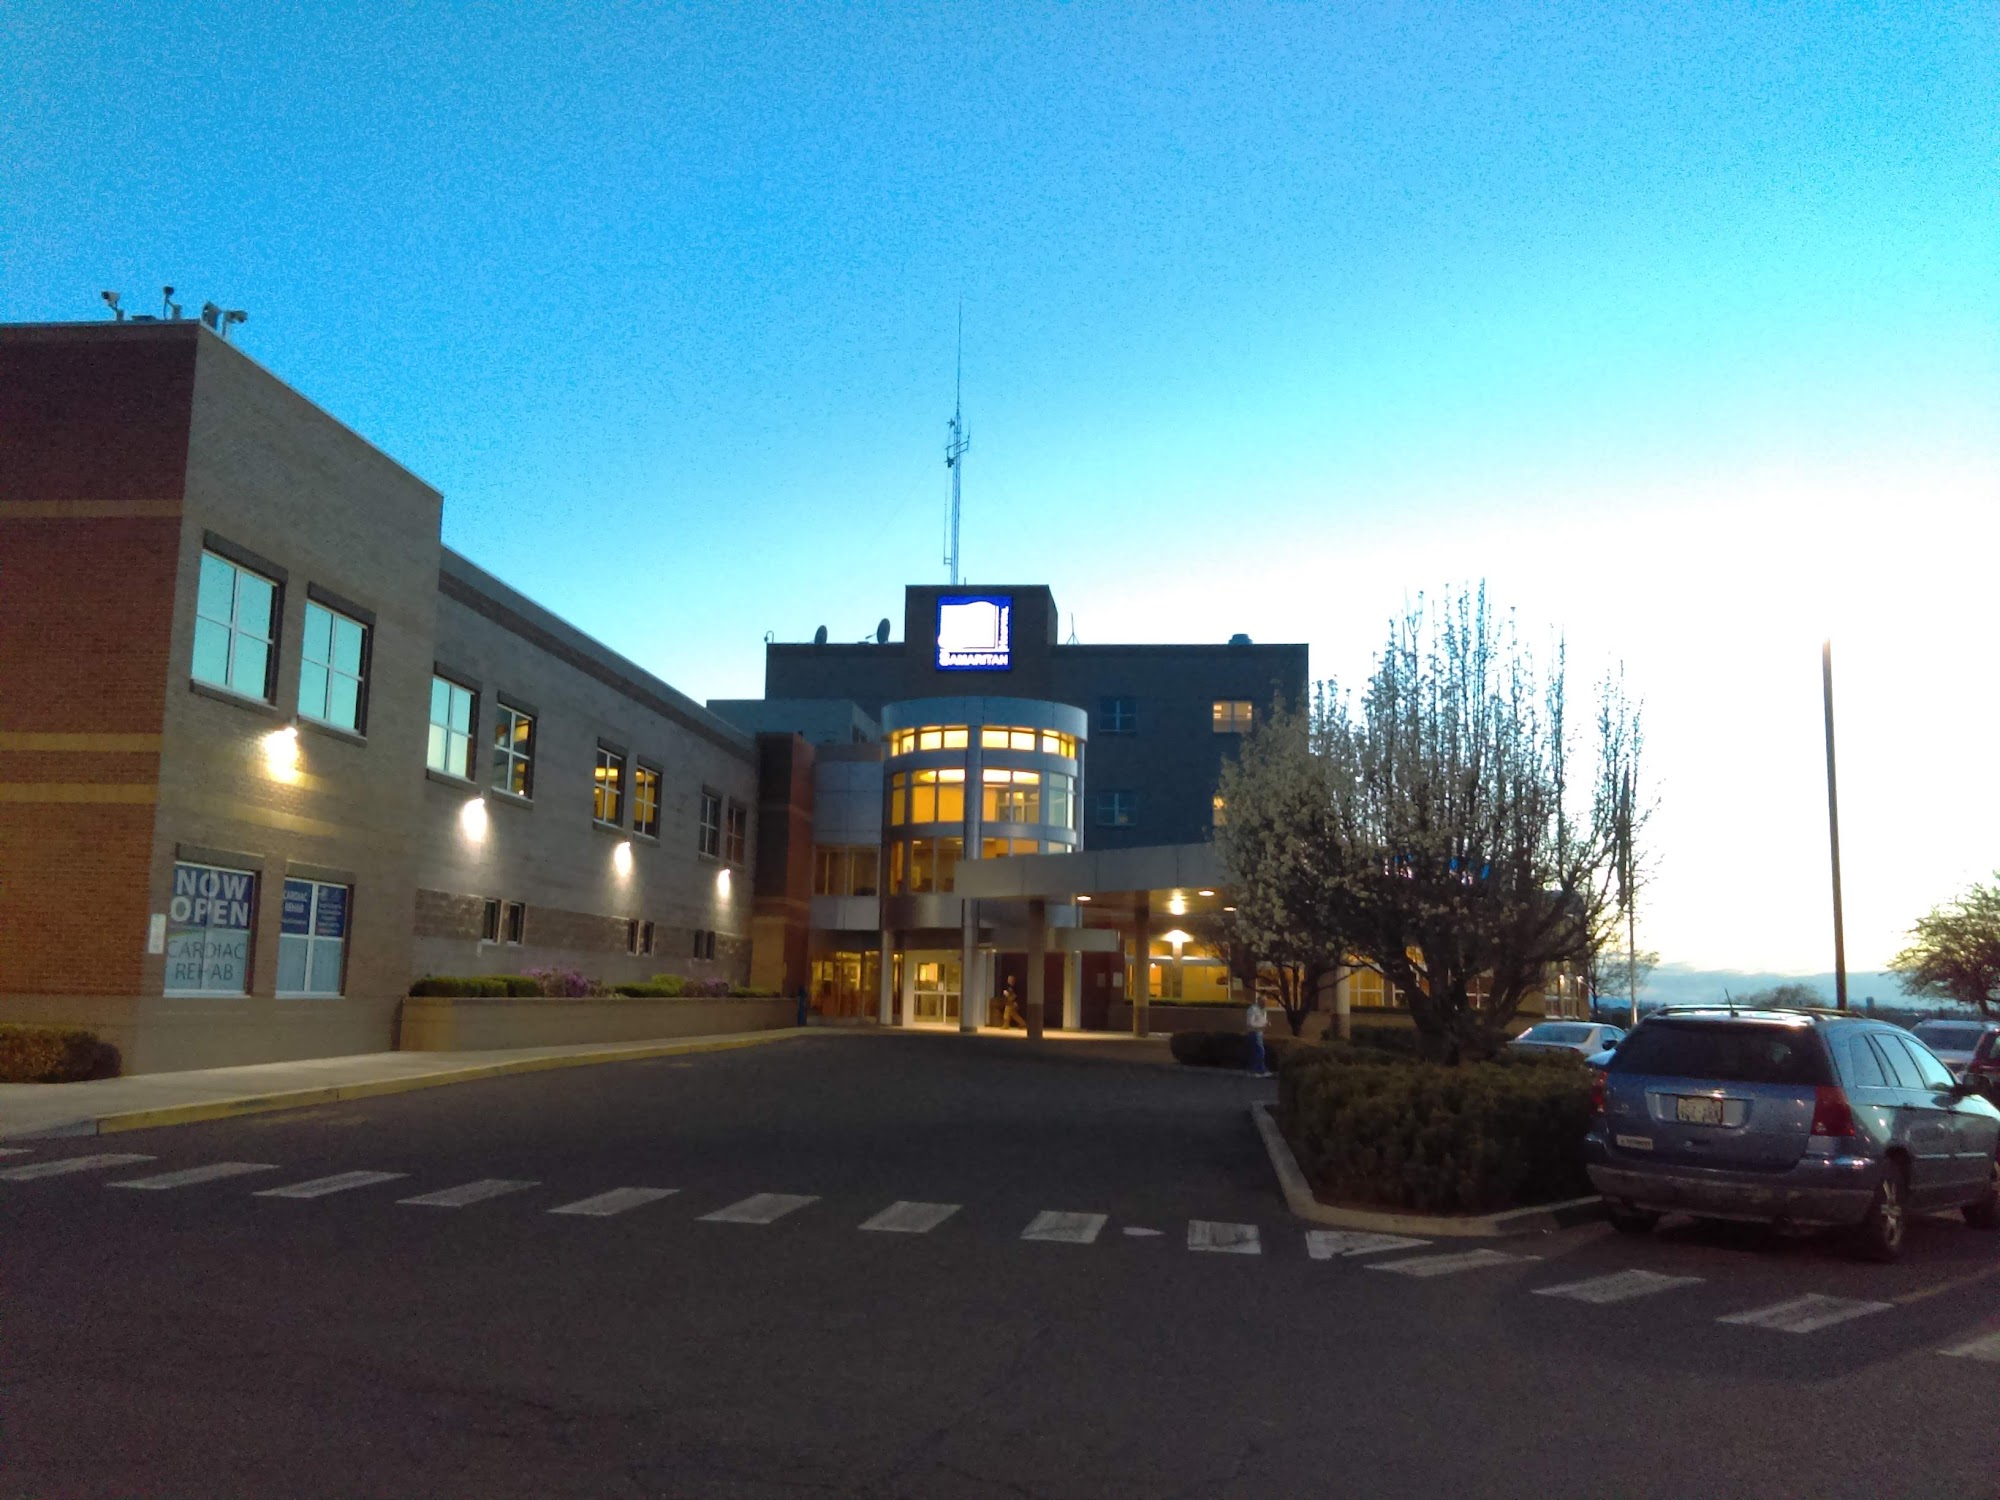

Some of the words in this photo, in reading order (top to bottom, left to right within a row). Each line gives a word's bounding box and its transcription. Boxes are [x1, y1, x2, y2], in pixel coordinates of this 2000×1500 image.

[939, 653, 1009, 667] SAMARITAN
[176, 869, 248, 900] NOW
[170, 896, 249, 927] OPEN
[167, 940, 245, 960] CARDIAC
[175, 962, 234, 981] REHAB
